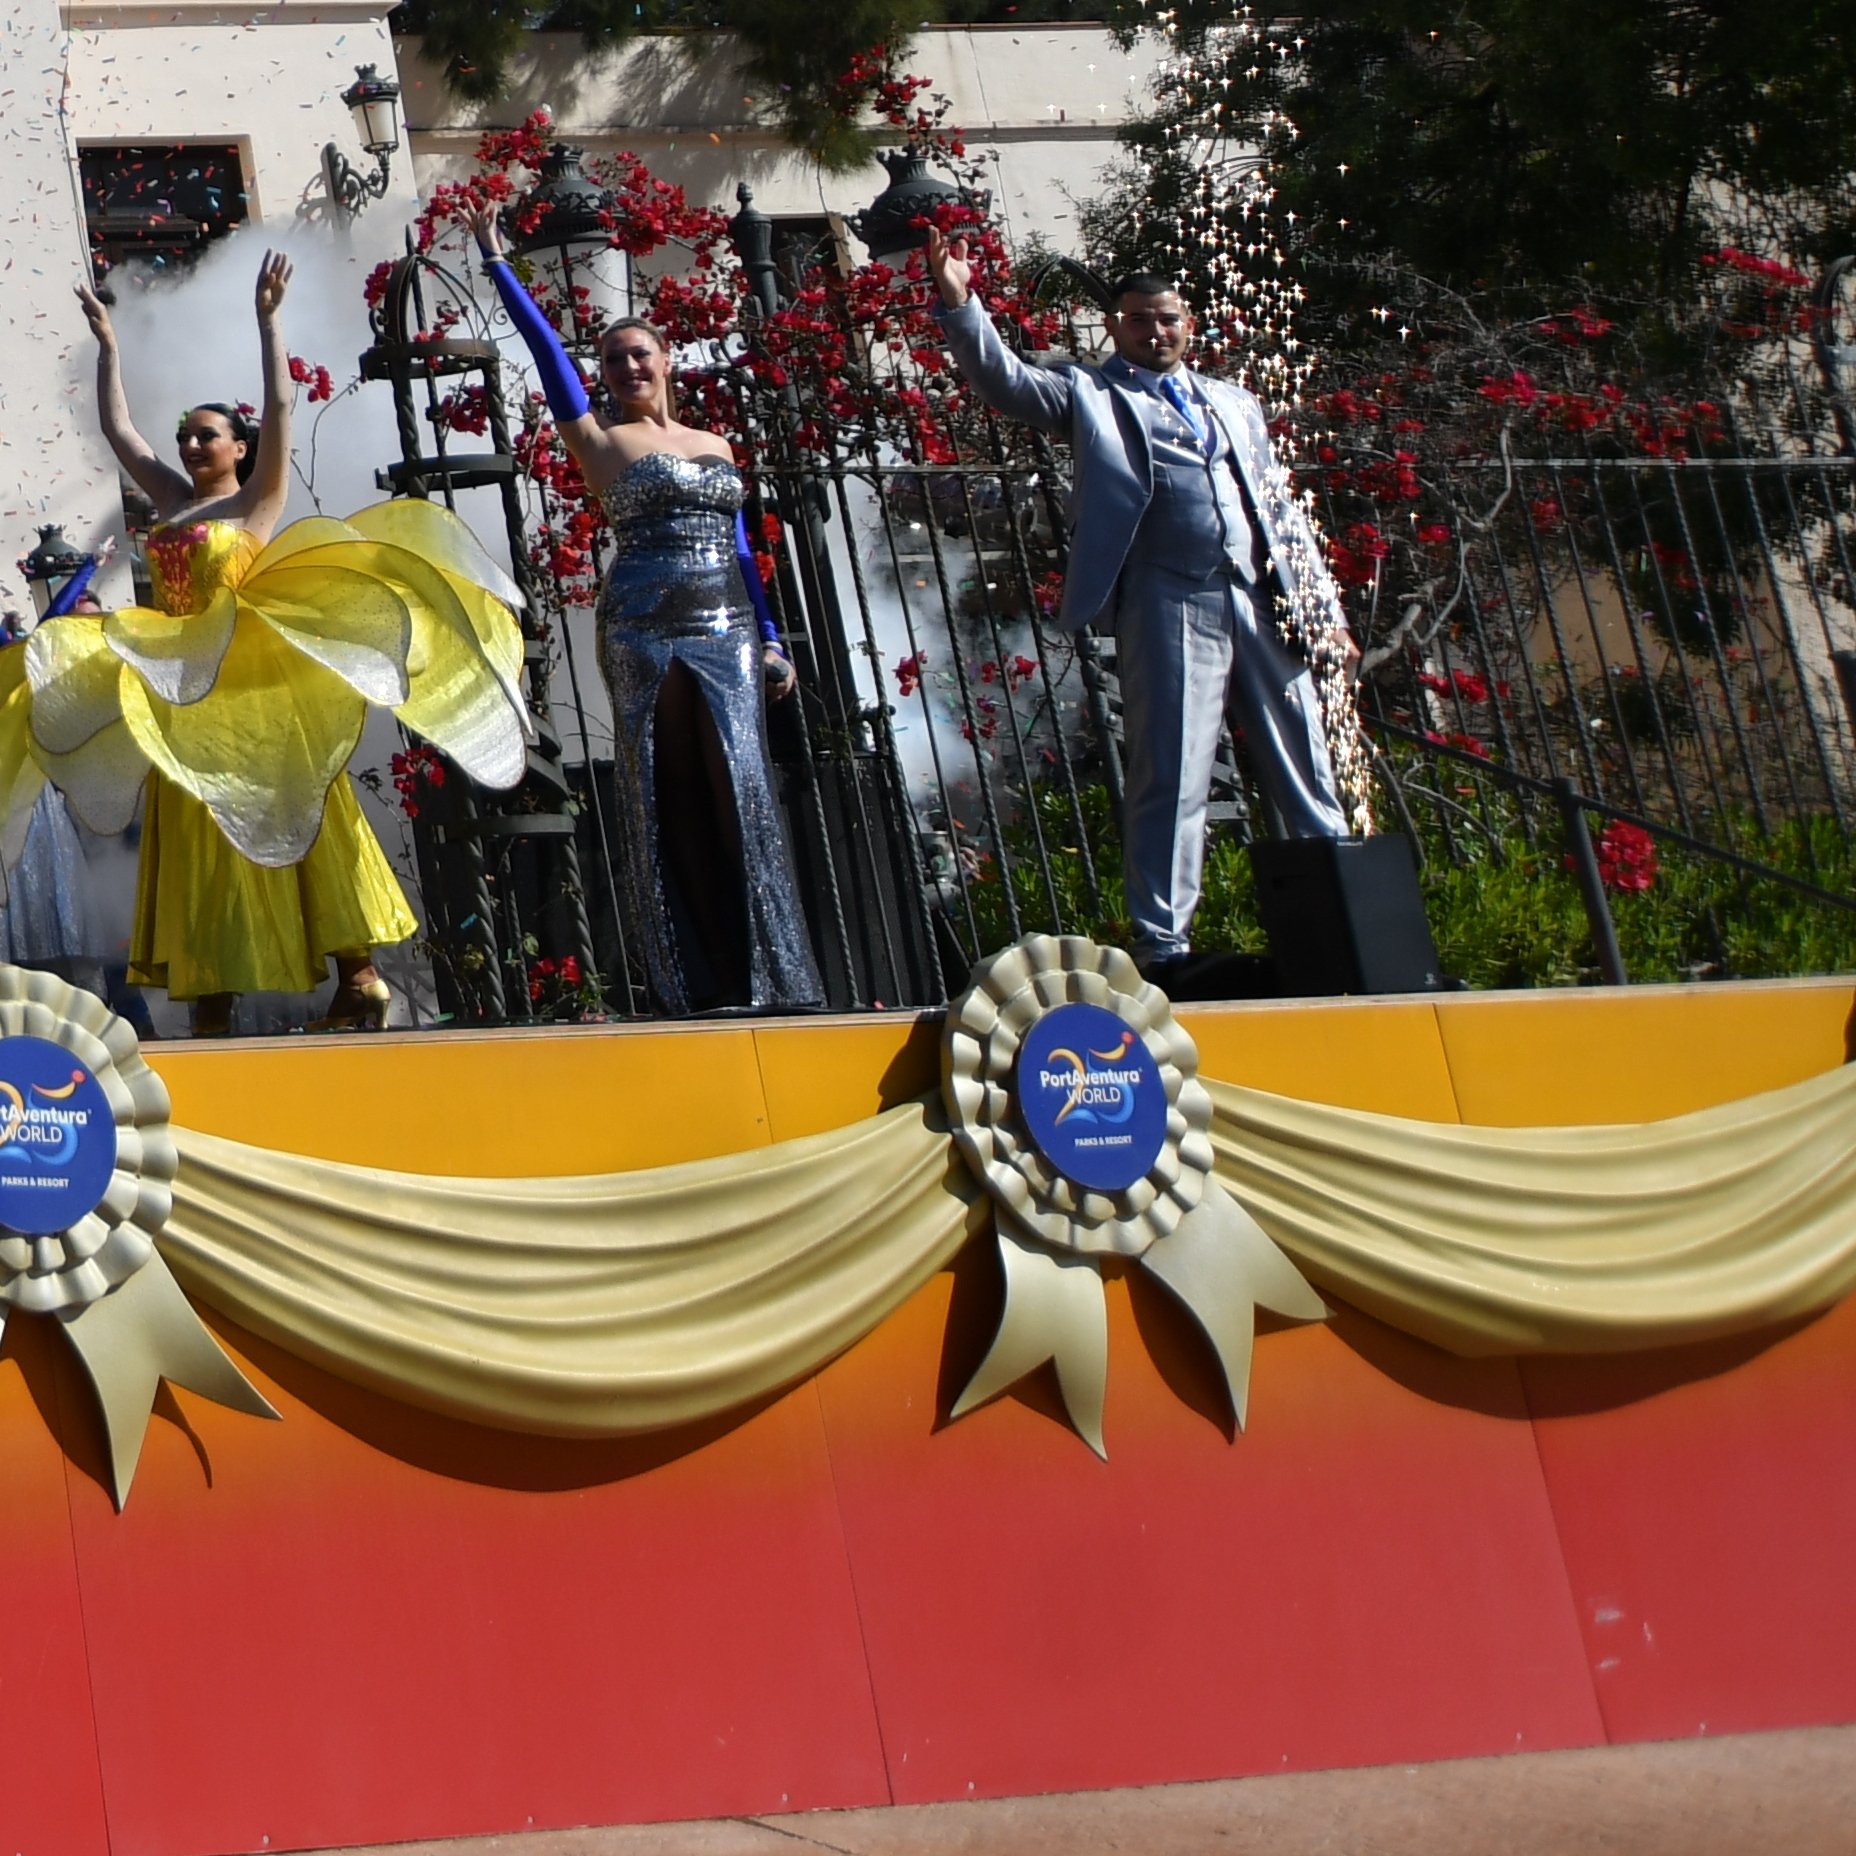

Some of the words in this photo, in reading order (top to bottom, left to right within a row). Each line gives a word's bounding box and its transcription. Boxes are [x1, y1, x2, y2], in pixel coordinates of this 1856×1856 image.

[1040, 1068, 1141, 1088] PortAventura
[1066, 1086, 1121, 1105] WORLD
[0, 1123, 63, 1143] WORLD
